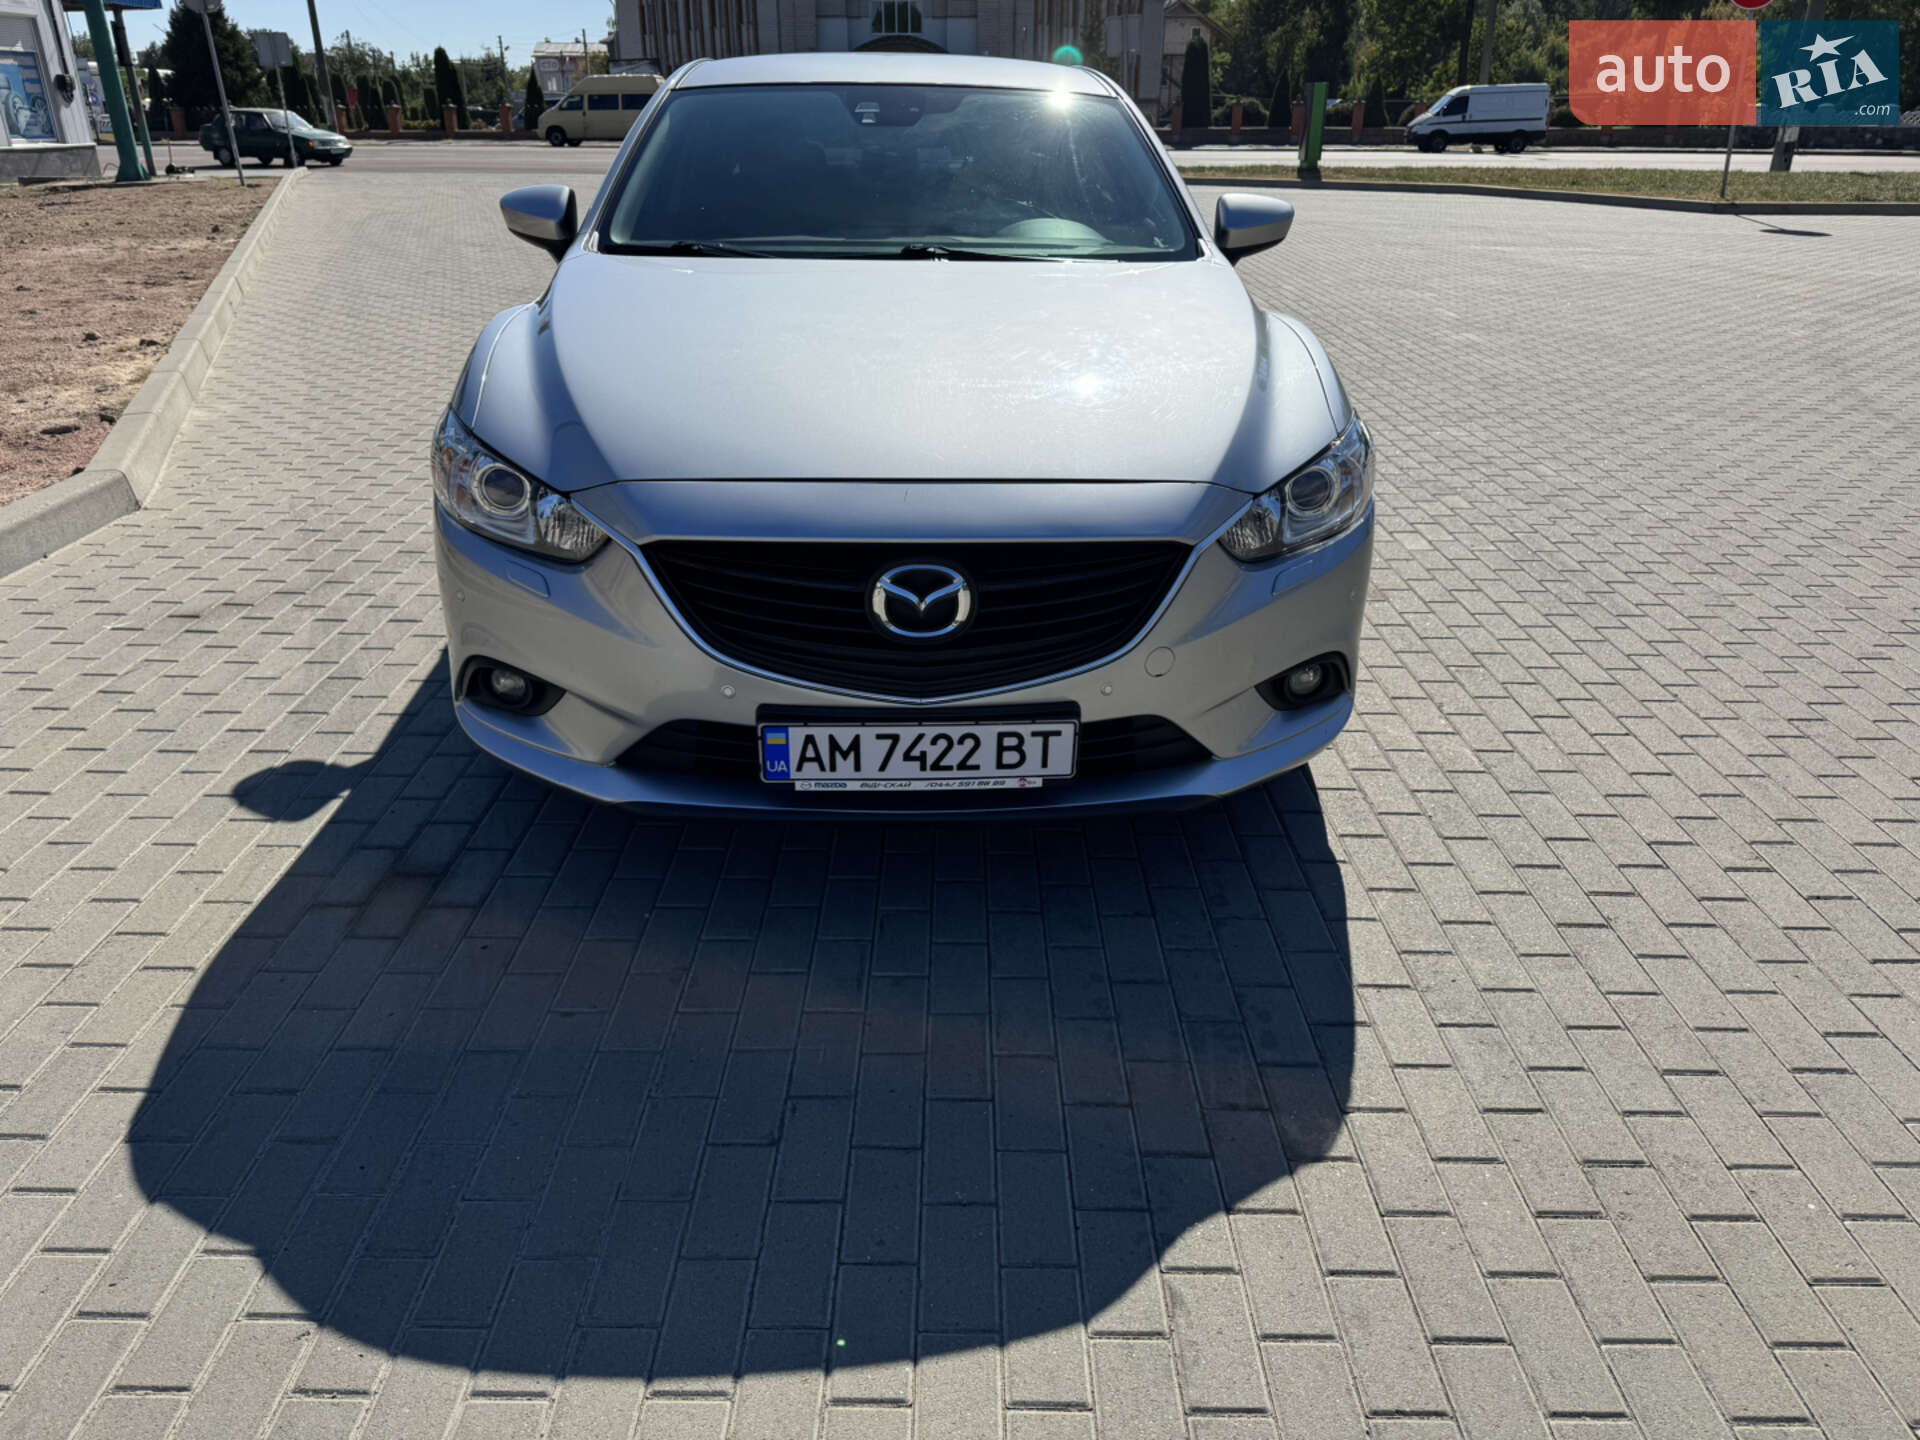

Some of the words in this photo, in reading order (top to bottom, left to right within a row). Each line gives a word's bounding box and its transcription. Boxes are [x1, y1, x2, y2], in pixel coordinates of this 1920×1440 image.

[795, 734, 861, 772] AM
[875, 732, 982, 772] 7422
[995, 730, 1062, 770] BT
[767, 760, 788, 773] UA
